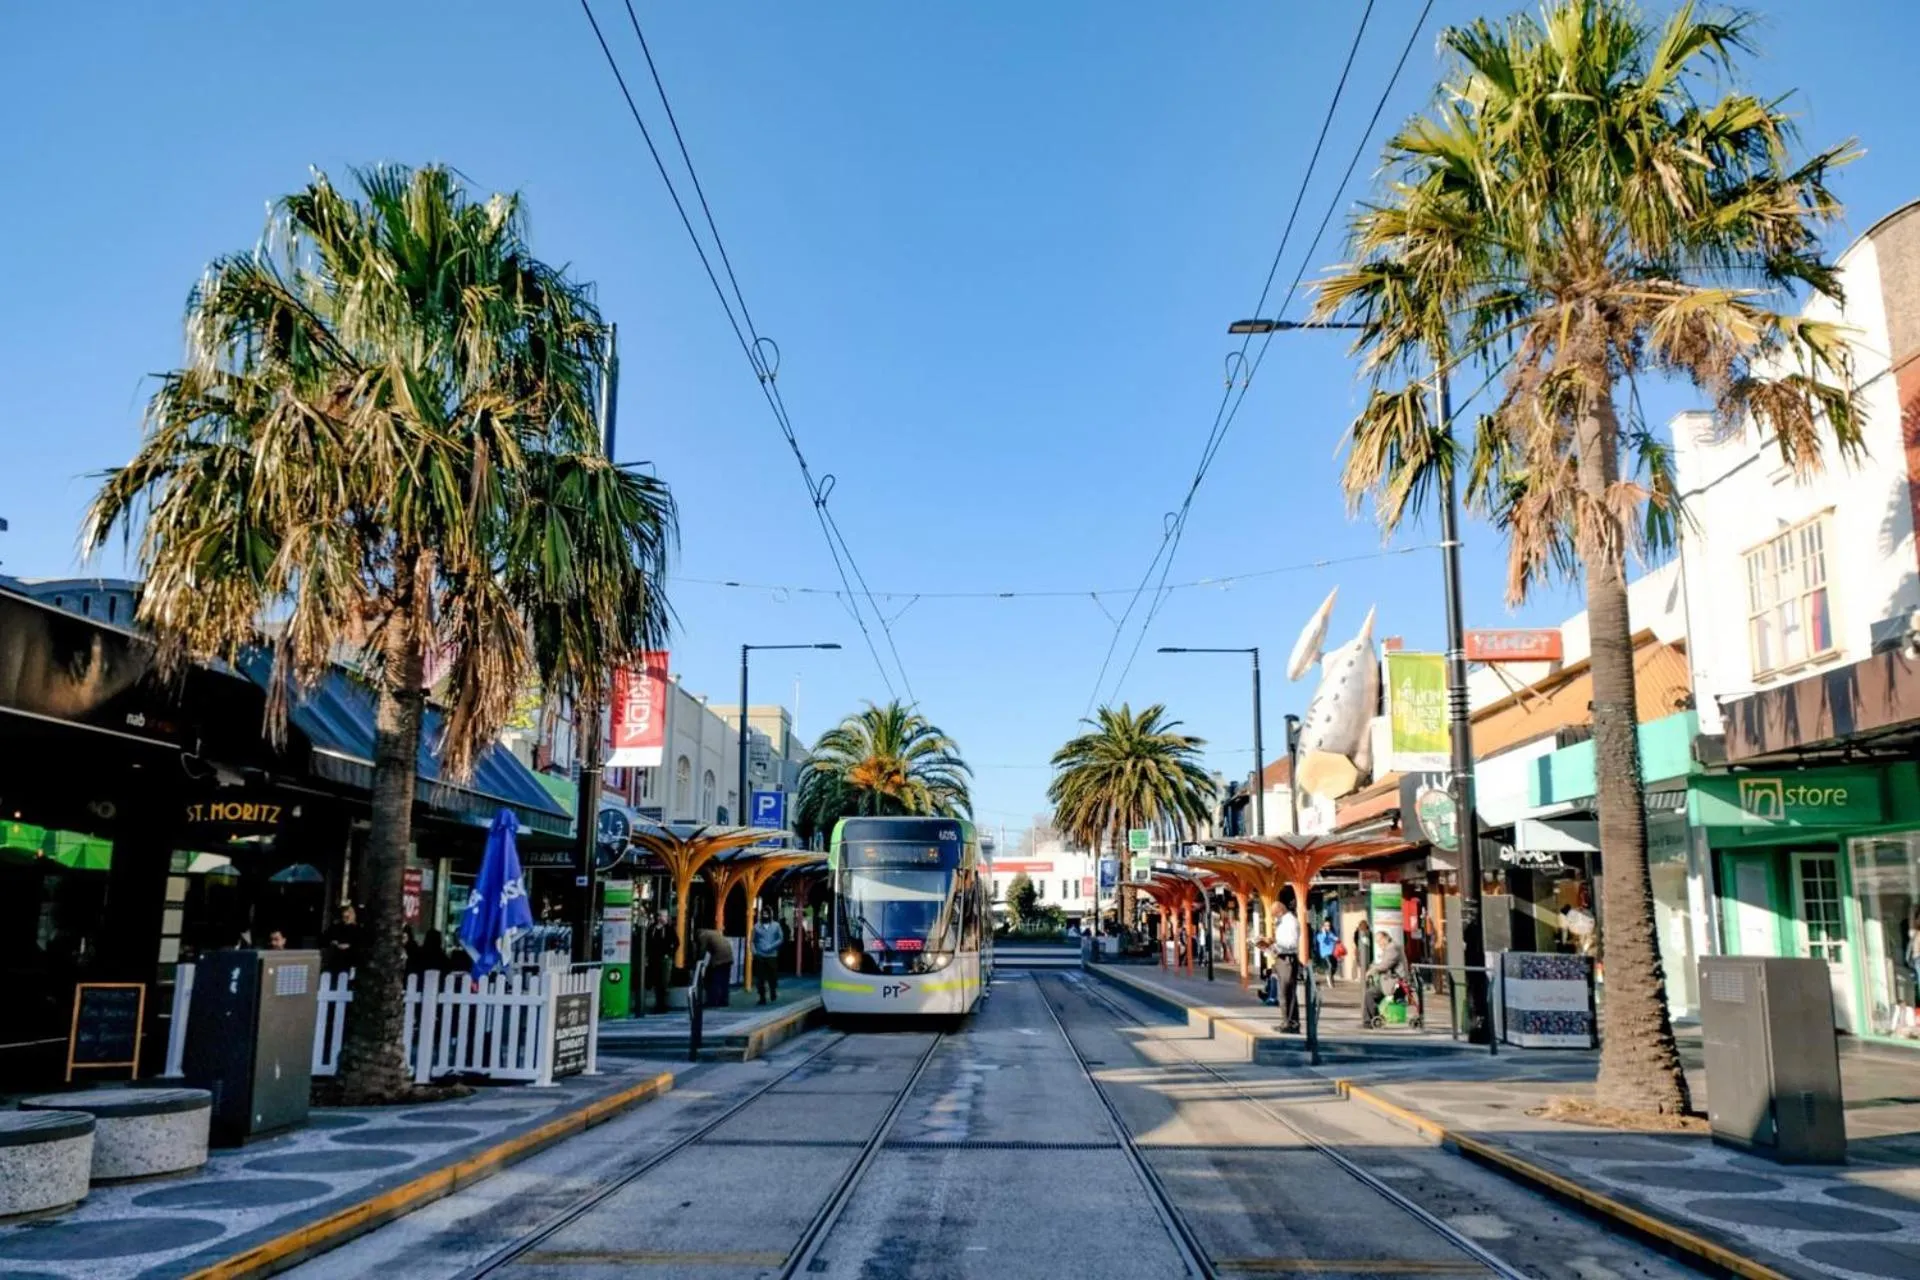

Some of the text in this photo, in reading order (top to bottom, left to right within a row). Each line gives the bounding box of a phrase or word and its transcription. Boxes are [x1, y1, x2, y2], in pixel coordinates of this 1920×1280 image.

[126, 712, 146, 727] nab
[1785, 785, 1848, 806] store
[210, 802, 282, 824] MORITZ
[759, 796, 776, 816] P
